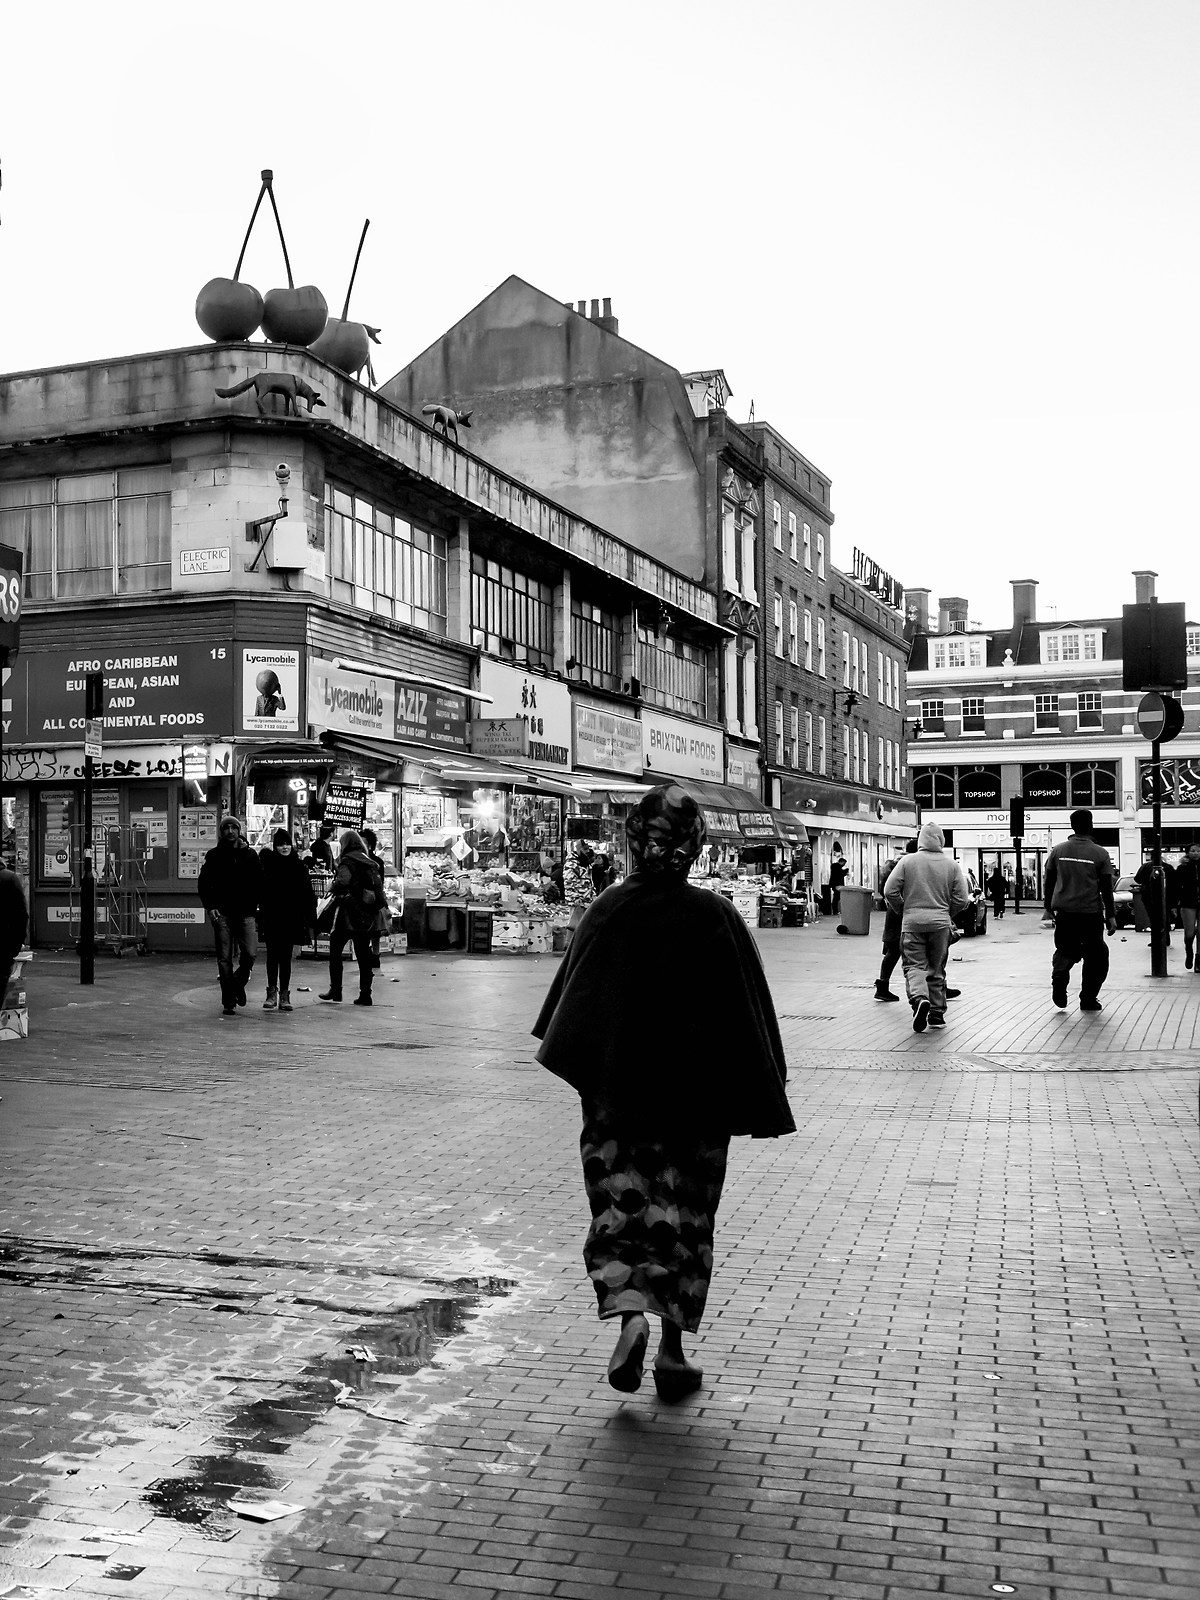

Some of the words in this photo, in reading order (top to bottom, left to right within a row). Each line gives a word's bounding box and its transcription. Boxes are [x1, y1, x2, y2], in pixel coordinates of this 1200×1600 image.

[184, 550, 227, 562] ELECTRIC
[184, 562, 208, 572] LANE
[210, 648, 226, 660] 15
[246, 654, 296, 664] Lycamobile
[68, 660, 100, 672] AFRO
[104, 655, 178, 670] CARIBBEAN
[141, 674, 180, 688] ASIAN
[108, 696, 135, 708] AND
[324, 678, 382, 717] Lycamobile
[397, 688, 427, 724] AZIZ
[42, 719, 65, 730] ALL
[160, 713, 204, 726] FOODS
[650, 728, 686, 755] BRIXTON
[690, 740, 716, 762] FOODS
[332, 789, 359, 798] WATCH
[326, 796, 362, 808] BATTERY
[326, 805, 361, 815] REPAIRING
[148, 911, 195, 920] Lycamobile
